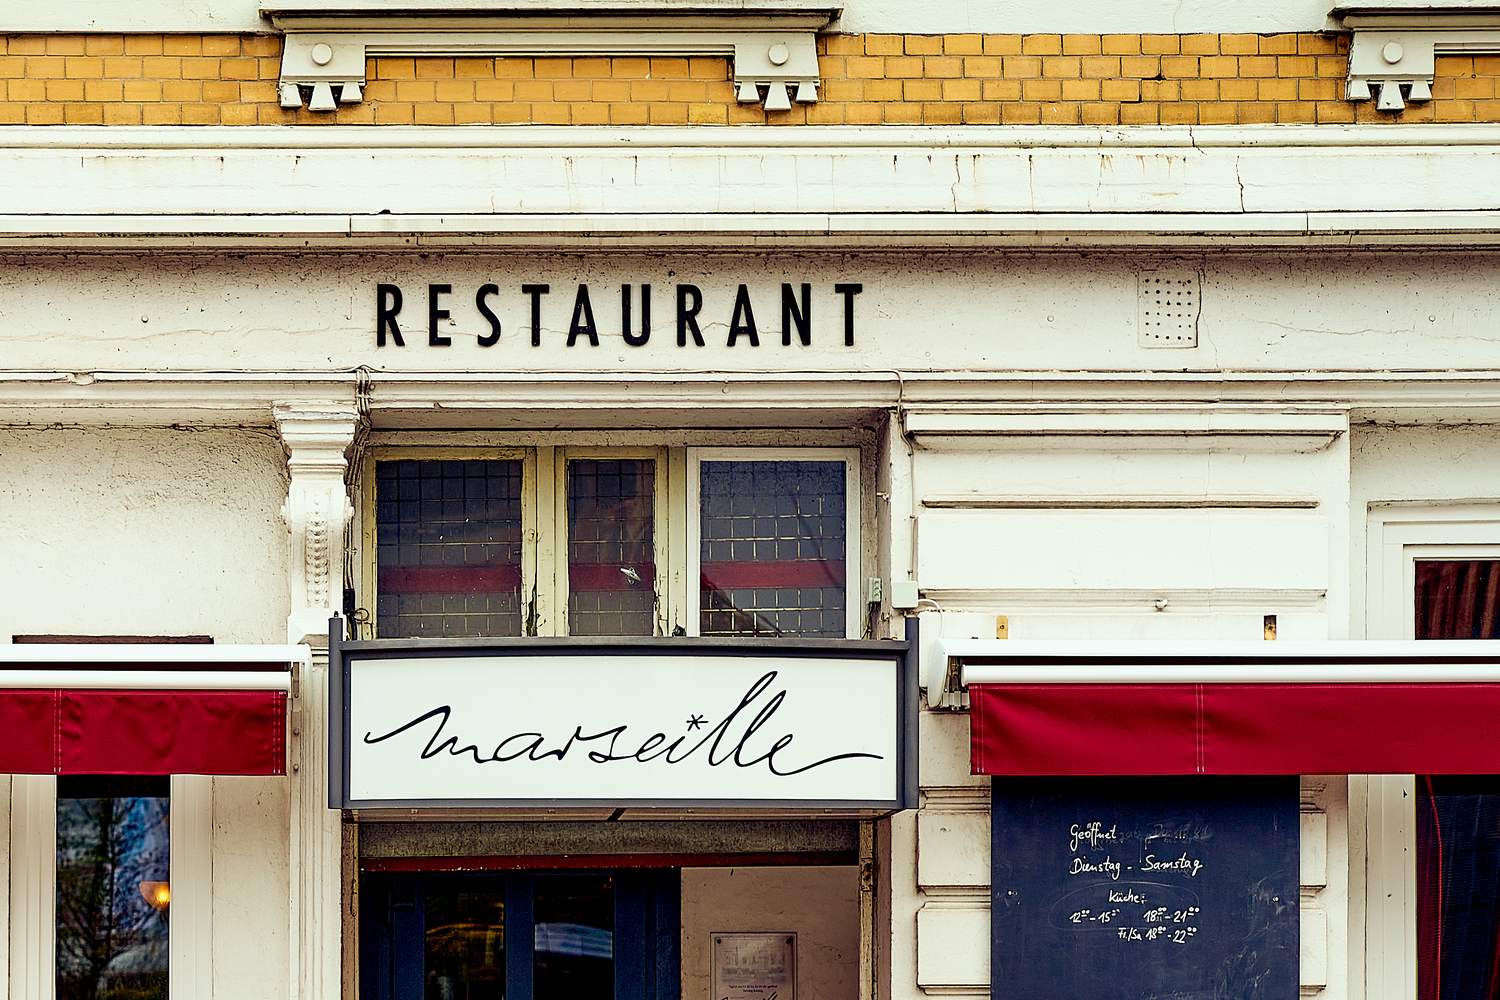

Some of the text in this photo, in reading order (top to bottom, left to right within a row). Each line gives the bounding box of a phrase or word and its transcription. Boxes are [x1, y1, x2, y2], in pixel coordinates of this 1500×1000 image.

[376, 283, 863, 347] RESTAURANT
[364, 671, 884, 776] marseille
[1070, 821, 1117, 851] Geöffnet
[1069, 855, 1121, 880] Dienstag
[1141, 851, 1204, 877] Samstag
